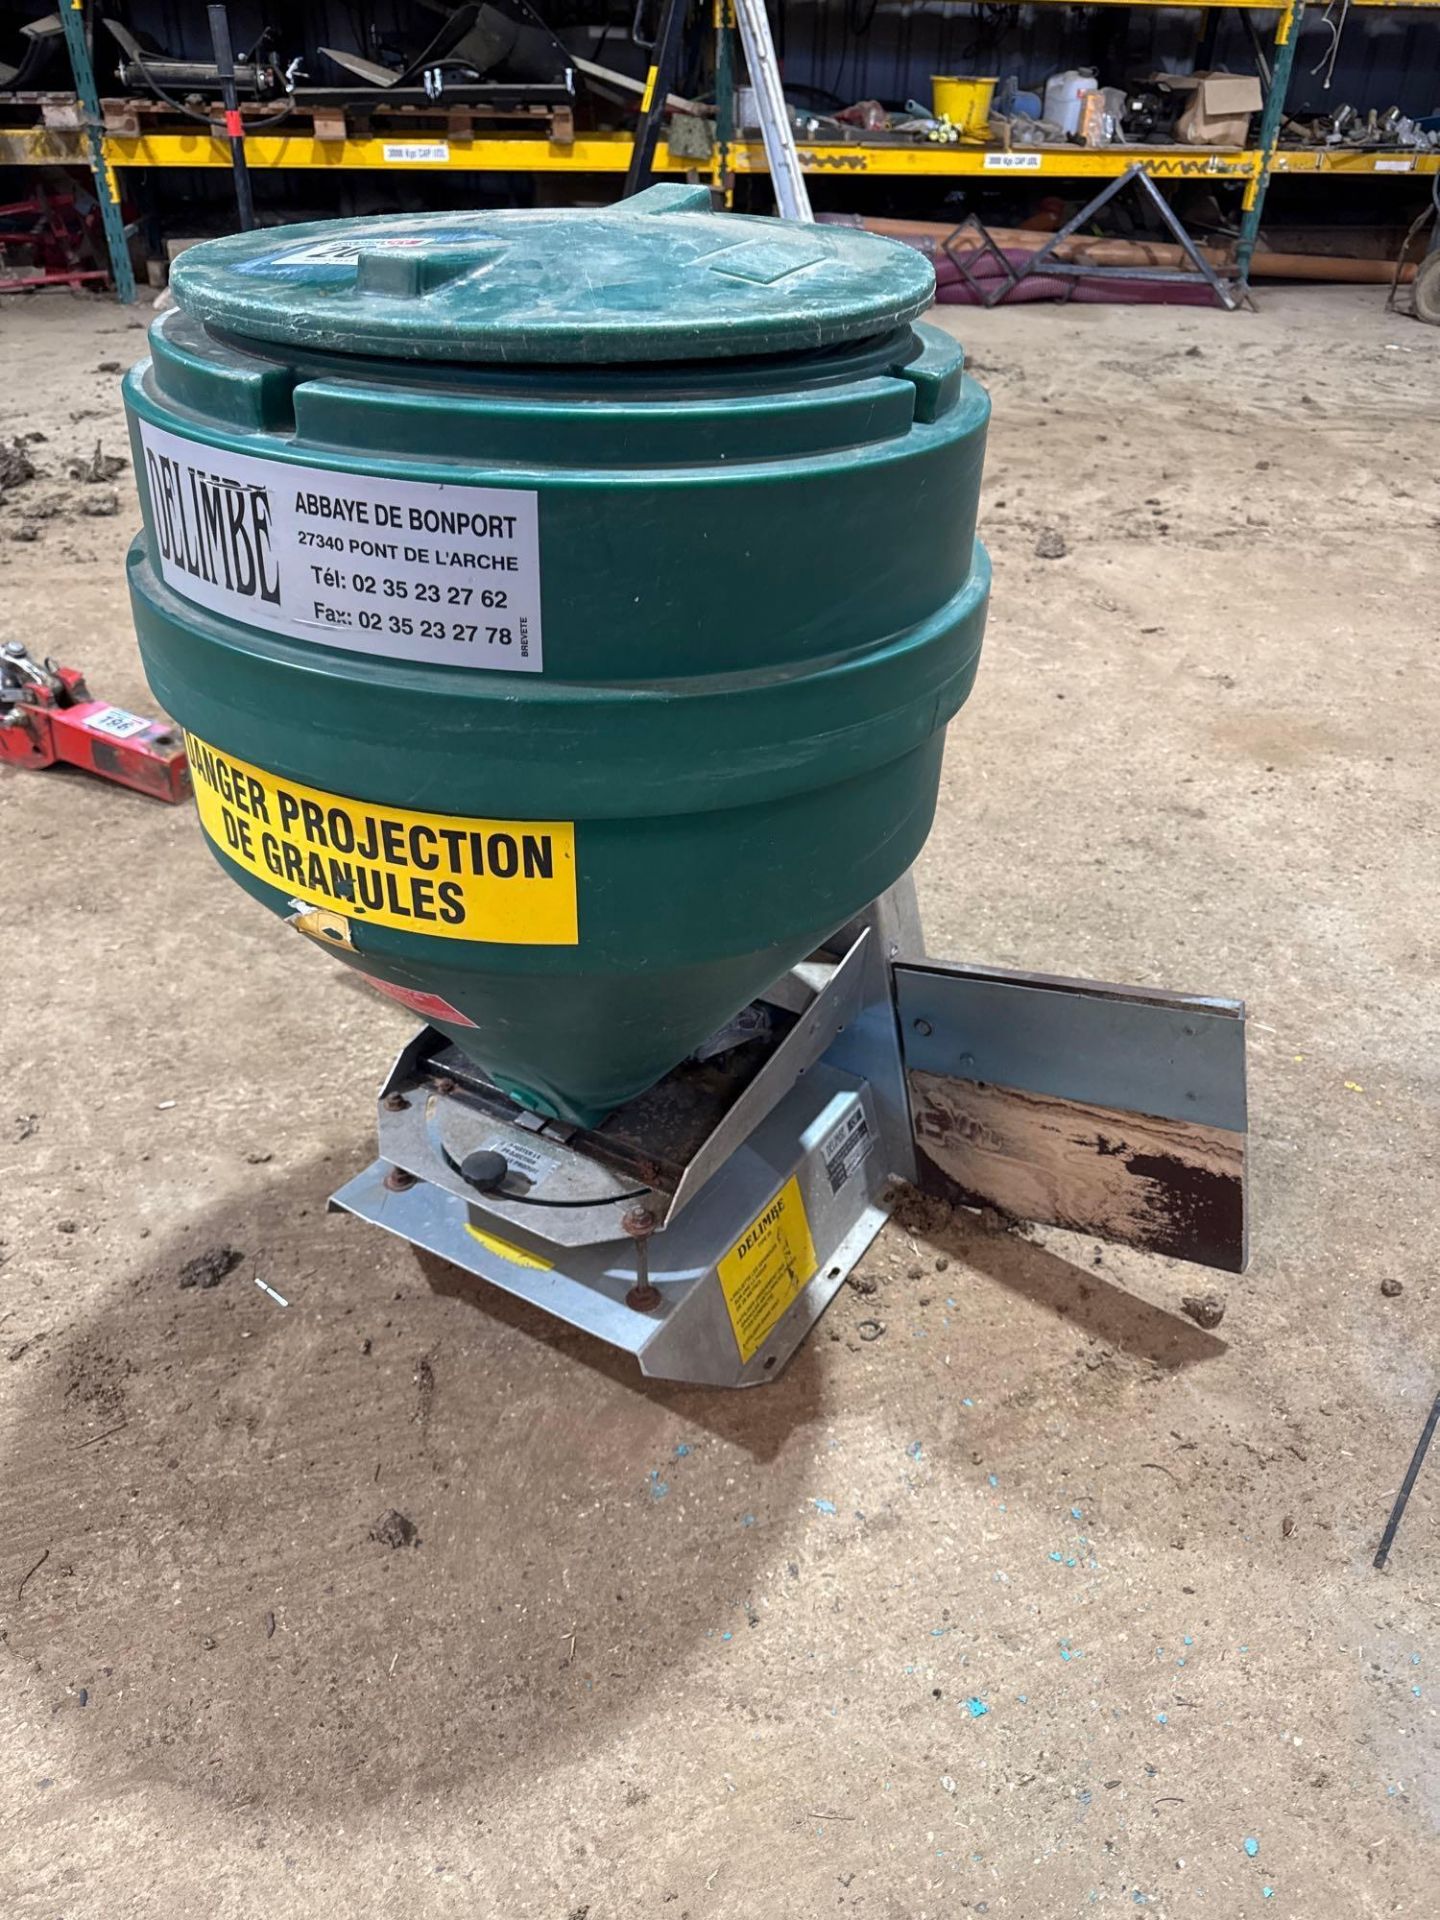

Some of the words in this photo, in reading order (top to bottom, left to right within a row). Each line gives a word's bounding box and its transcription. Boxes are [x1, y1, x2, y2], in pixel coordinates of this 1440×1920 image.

[146, 447, 281, 606] DELIMBE
[295, 491, 369, 524] ABBAYE
[374, 504, 403, 529] DE
[408, 507, 517, 539] BONPORT
[298, 531, 344, 551] 27340
[349, 538, 398, 560] PONT
[404, 547, 430, 564] DE
[435, 550, 519, 572] L'ARCHE
[310, 565, 347, 589] Tél:
[352, 574, 377, 594] 02
[383, 579, 408, 599] 35
[415, 583, 441, 603] 23
[447, 587, 473, 606] 27
[481, 590, 508, 609] 62
[313, 601, 352, 625] Fax:
[358, 611, 383, 631] 02
[388, 616, 414, 636] 35
[420, 620, 446, 640] 23
[452, 624, 478, 642] 27
[485, 627, 512, 646] 78
[187, 731, 271, 825] DANGER
[277, 790, 553, 879] PROJECTION
[222, 805, 256, 863] DE
[262, 832, 466, 925] GRANULES
[737, 1197, 786, 1261] DELIMBE
